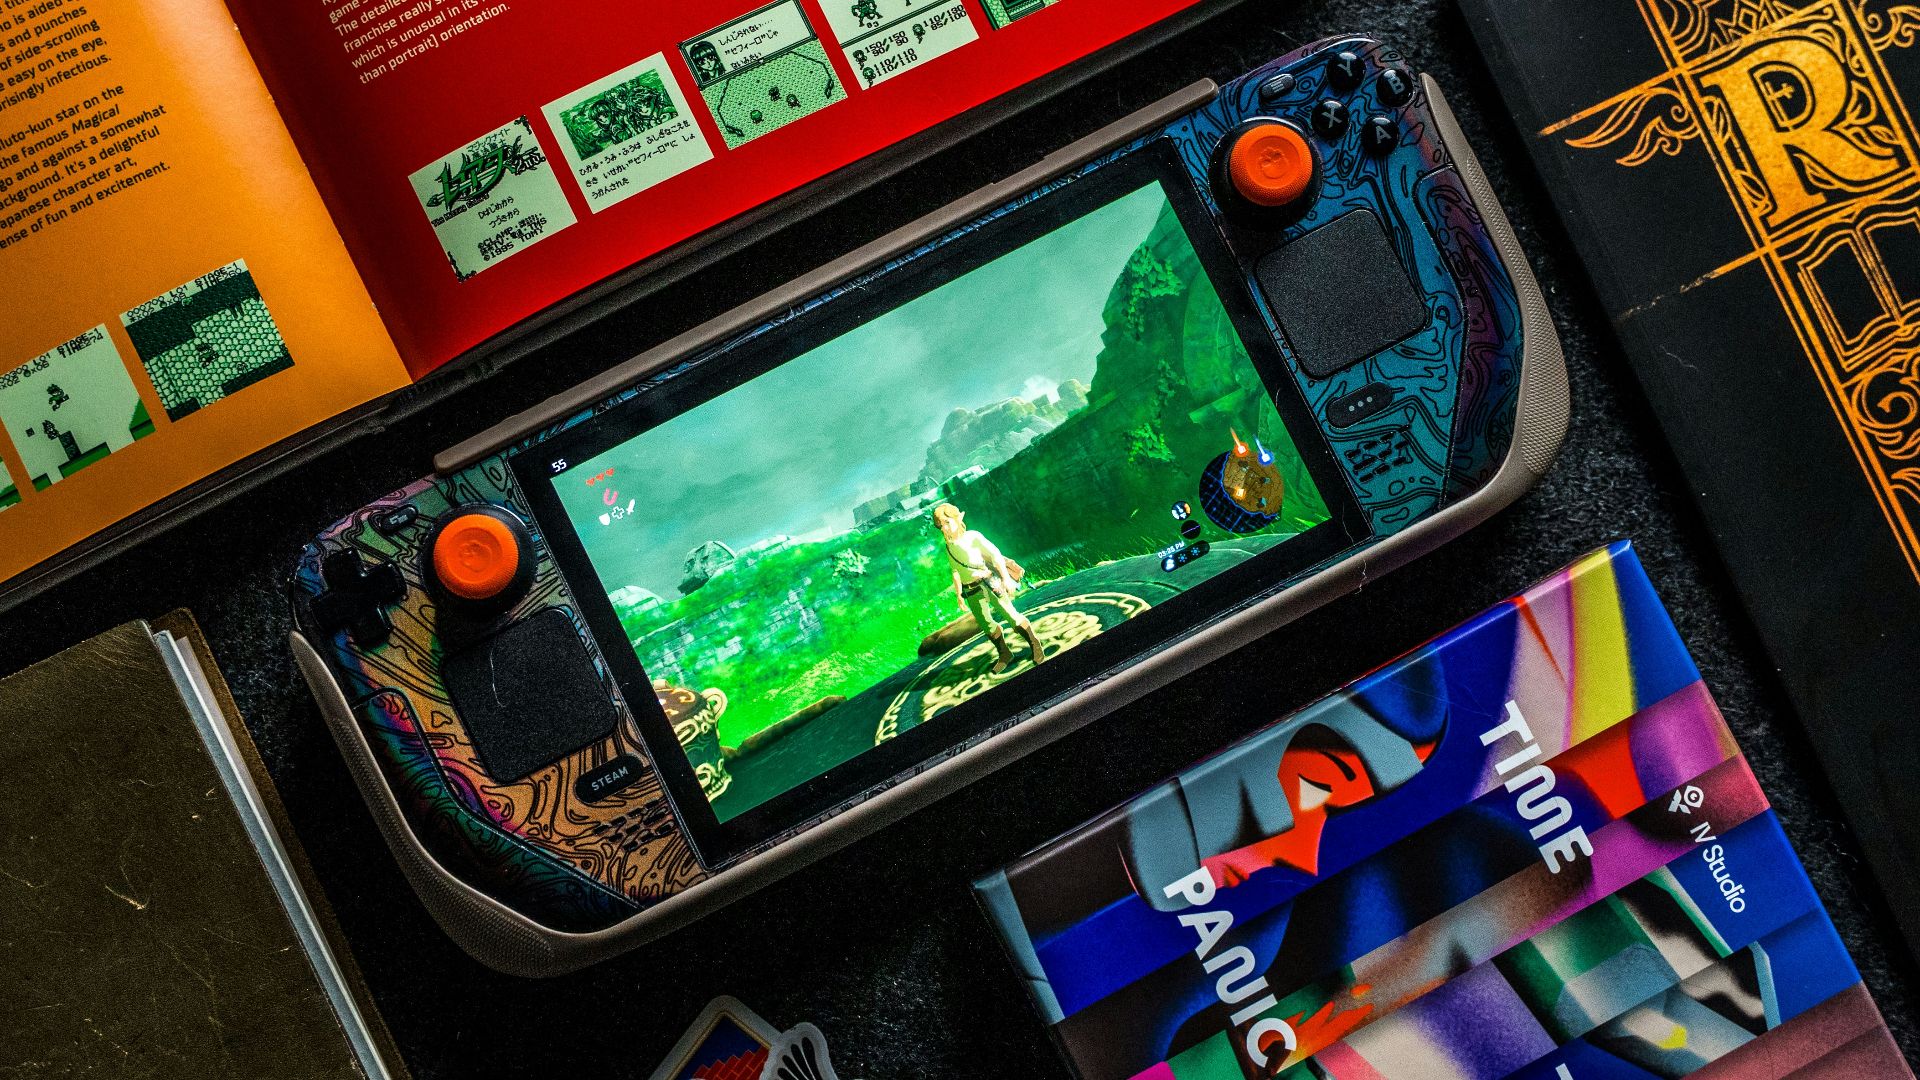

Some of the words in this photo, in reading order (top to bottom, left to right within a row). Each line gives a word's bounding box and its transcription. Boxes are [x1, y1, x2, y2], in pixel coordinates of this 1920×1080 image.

[7, 29, 32, 47] and
[33, 6, 87, 37] punches
[12, 14, 26, 25] is
[27, 0, 63, 19] aided
[334, 19, 359, 37] The
[343, 18, 398, 53] franchise
[399, 0, 433, 23] really
[351, 44, 386, 69] which
[385, 38, 399, 50] is
[399, 11, 447, 42] unusual
[446, 6, 461, 18] in
[0, 56, 12, 71] of
[14, 19, 101, 64] side-scrolling
[7, 67, 36, 87] easy
[37, 58, 55, 72] on
[56, 47, 79, 63] the
[81, 37, 108, 52] eye,
[359, 64, 387, 84] than
[439, 3, 511, 42] orientation.
[1337, 57, 1352, 77] Y
[45, 54, 112, 88] infectious.
[1386, 76, 1406, 95] B
[0, 116, 54, 150] luto-kun
[55, 104, 81, 122] star
[83, 96, 100, 109] on
[101, 85, 124, 101] the
[0, 154, 20, 169] the
[21, 130, 69, 158] famous
[72, 104, 120, 135] Magical
[16, 161, 40, 181] and
[42, 139, 88, 167] against
[90, 135, 98, 145] a
[100, 104, 167, 140] somewhat
[1321, 106, 1343, 129] X
[1375, 125, 1392, 145] A
[1700, 34, 1900, 227] R
[65, 159, 86, 176] It's
[88, 155, 97, 165] a
[98, 126, 160, 160] delightful
[0, 197, 51, 229] apanese
[53, 167, 111, 202] character
[114, 156, 137, 173] art,
[0, 228, 29, 249] ense
[30, 218, 43, 234] of
[45, 208, 68, 225] fun
[70, 193, 94, 214] and
[96, 161, 171, 201] excitement.
[551, 458, 567, 473] 55
[591, 766, 630, 791] STEAM
[1478, 699, 1594, 874] TIME
[1690, 821, 1717, 843] IV
[1702, 844, 1746, 913] Studio
[1162, 865, 1297, 1068] PANIC
